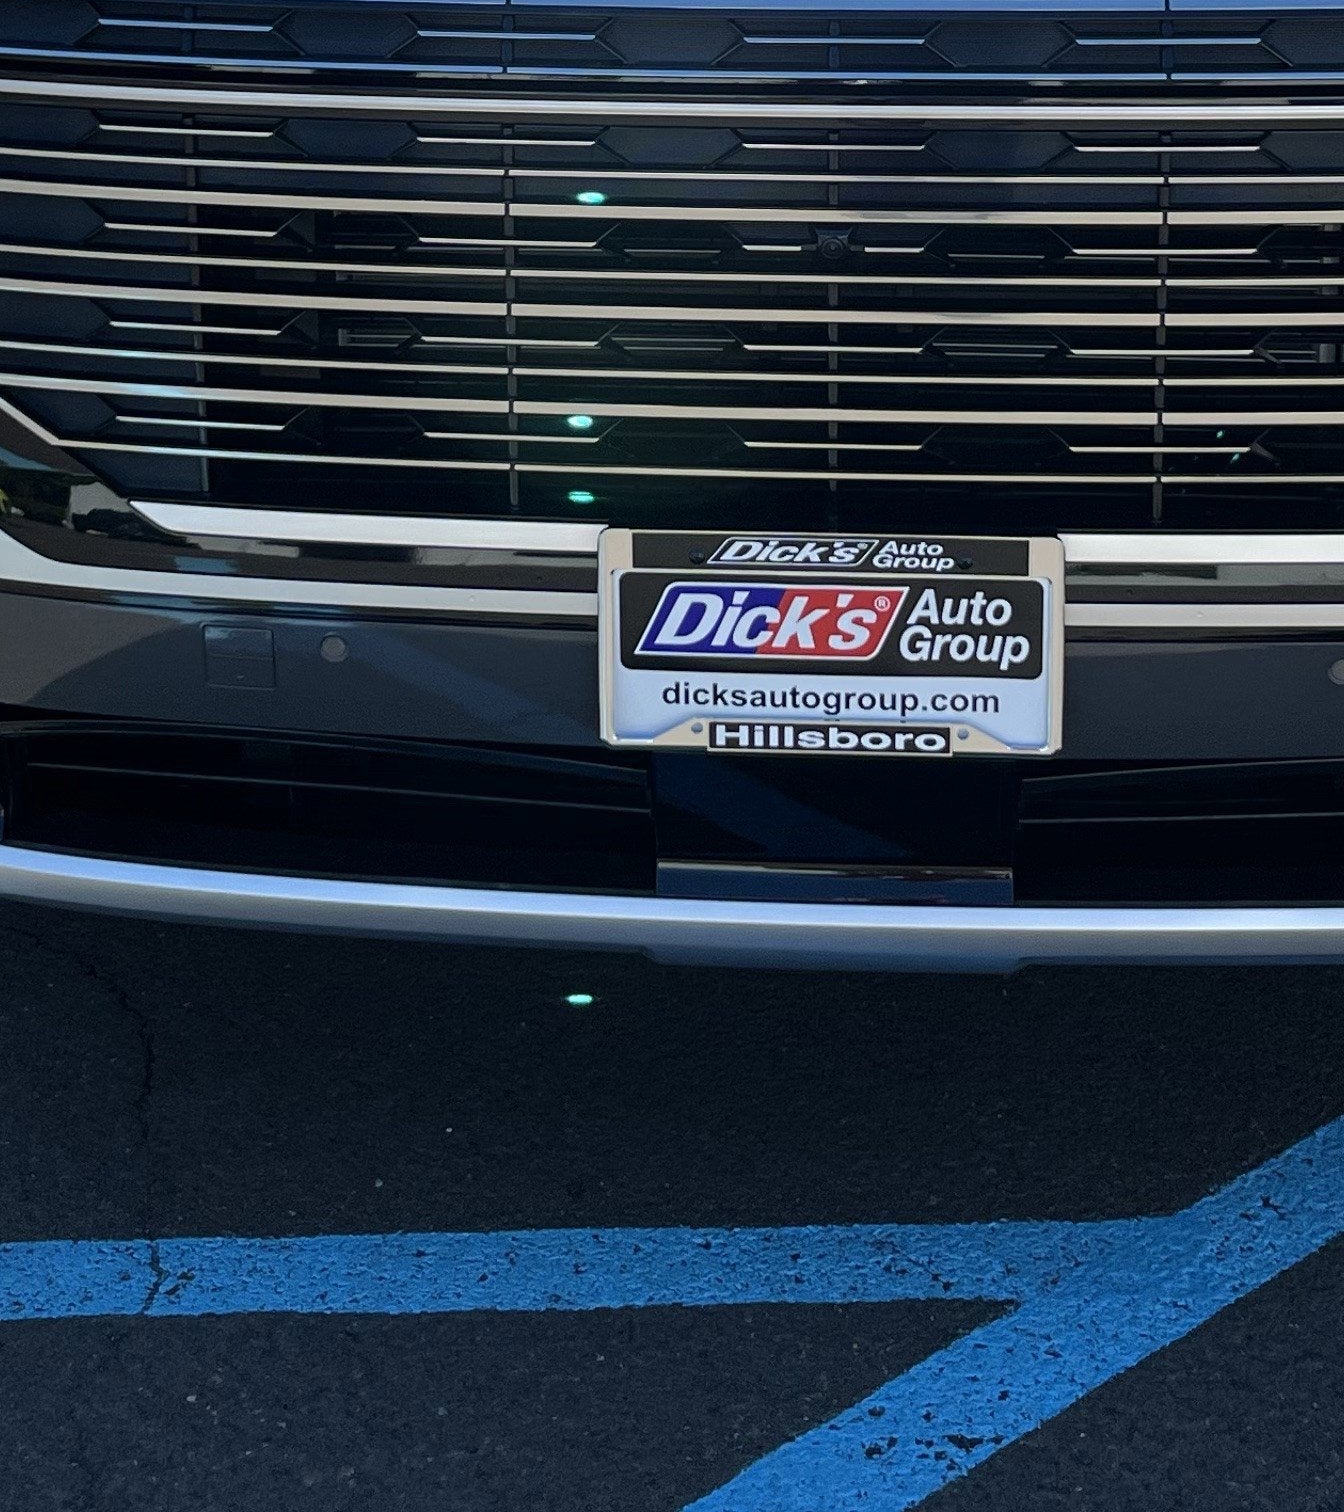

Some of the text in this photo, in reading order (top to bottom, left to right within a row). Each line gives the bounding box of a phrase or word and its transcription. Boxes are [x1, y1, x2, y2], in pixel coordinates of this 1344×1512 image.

[719, 541, 861, 564] Dick's
[872, 553, 955, 572] Group
[878, 540, 944, 556] Auto
[653, 590, 877, 651] Dick's
[906, 588, 1013, 627] Auto
[899, 625, 1030, 671] Group
[661, 681, 1001, 716] dicksautogroup.com
[714, 723, 947, 752] Hillsboro
